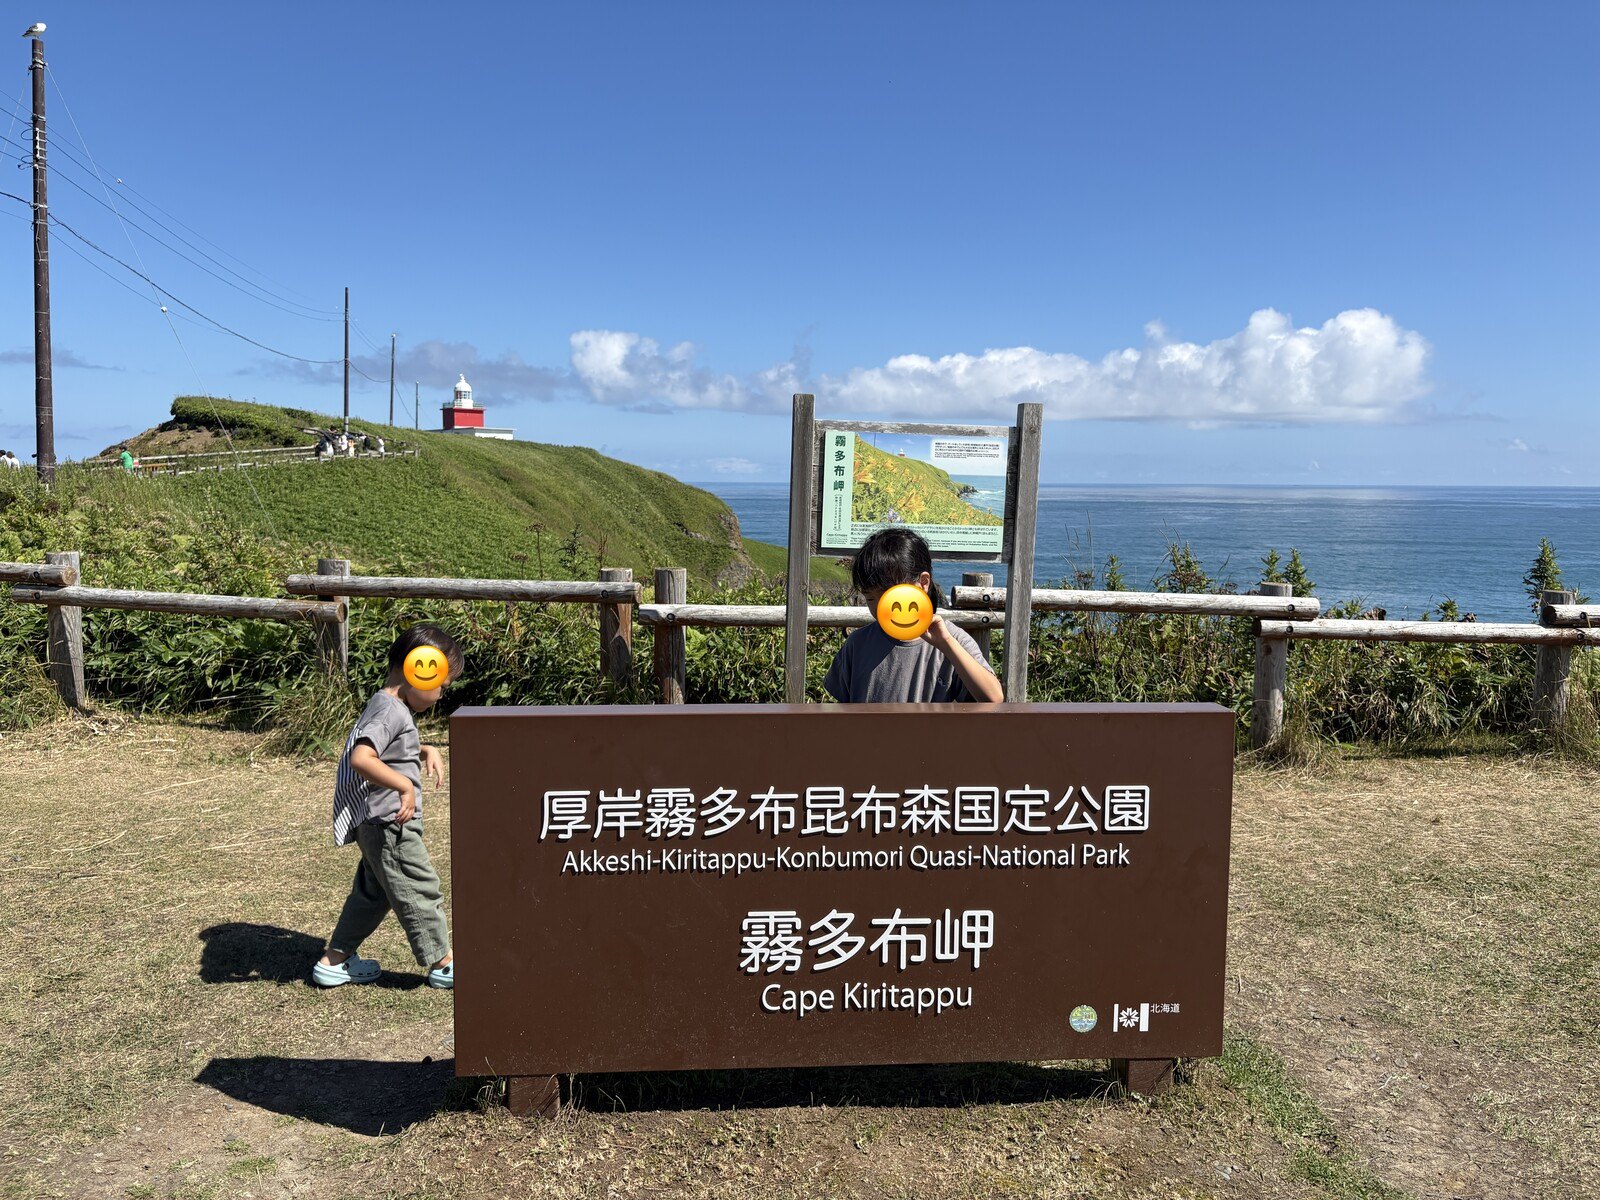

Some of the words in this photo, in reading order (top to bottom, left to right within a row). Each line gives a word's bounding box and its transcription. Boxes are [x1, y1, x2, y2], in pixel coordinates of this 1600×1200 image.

[833, 435, 846, 491] 霧多布岬
[540, 784, 1150, 839] 厚岸霧多布昆布森国定公園
[562, 845, 904, 875] Akkeshi-Kiritappu-Konbumori
[910, 844, 1075, 869] Quasi-National
[1083, 843, 1130, 866] Park
[739, 908, 994, 973] 霧多布岬
[762, 983, 835, 1017] Cape
[844, 982, 972, 1014] Kiritappu
[1150, 1003, 1180, 1014] 北海道
